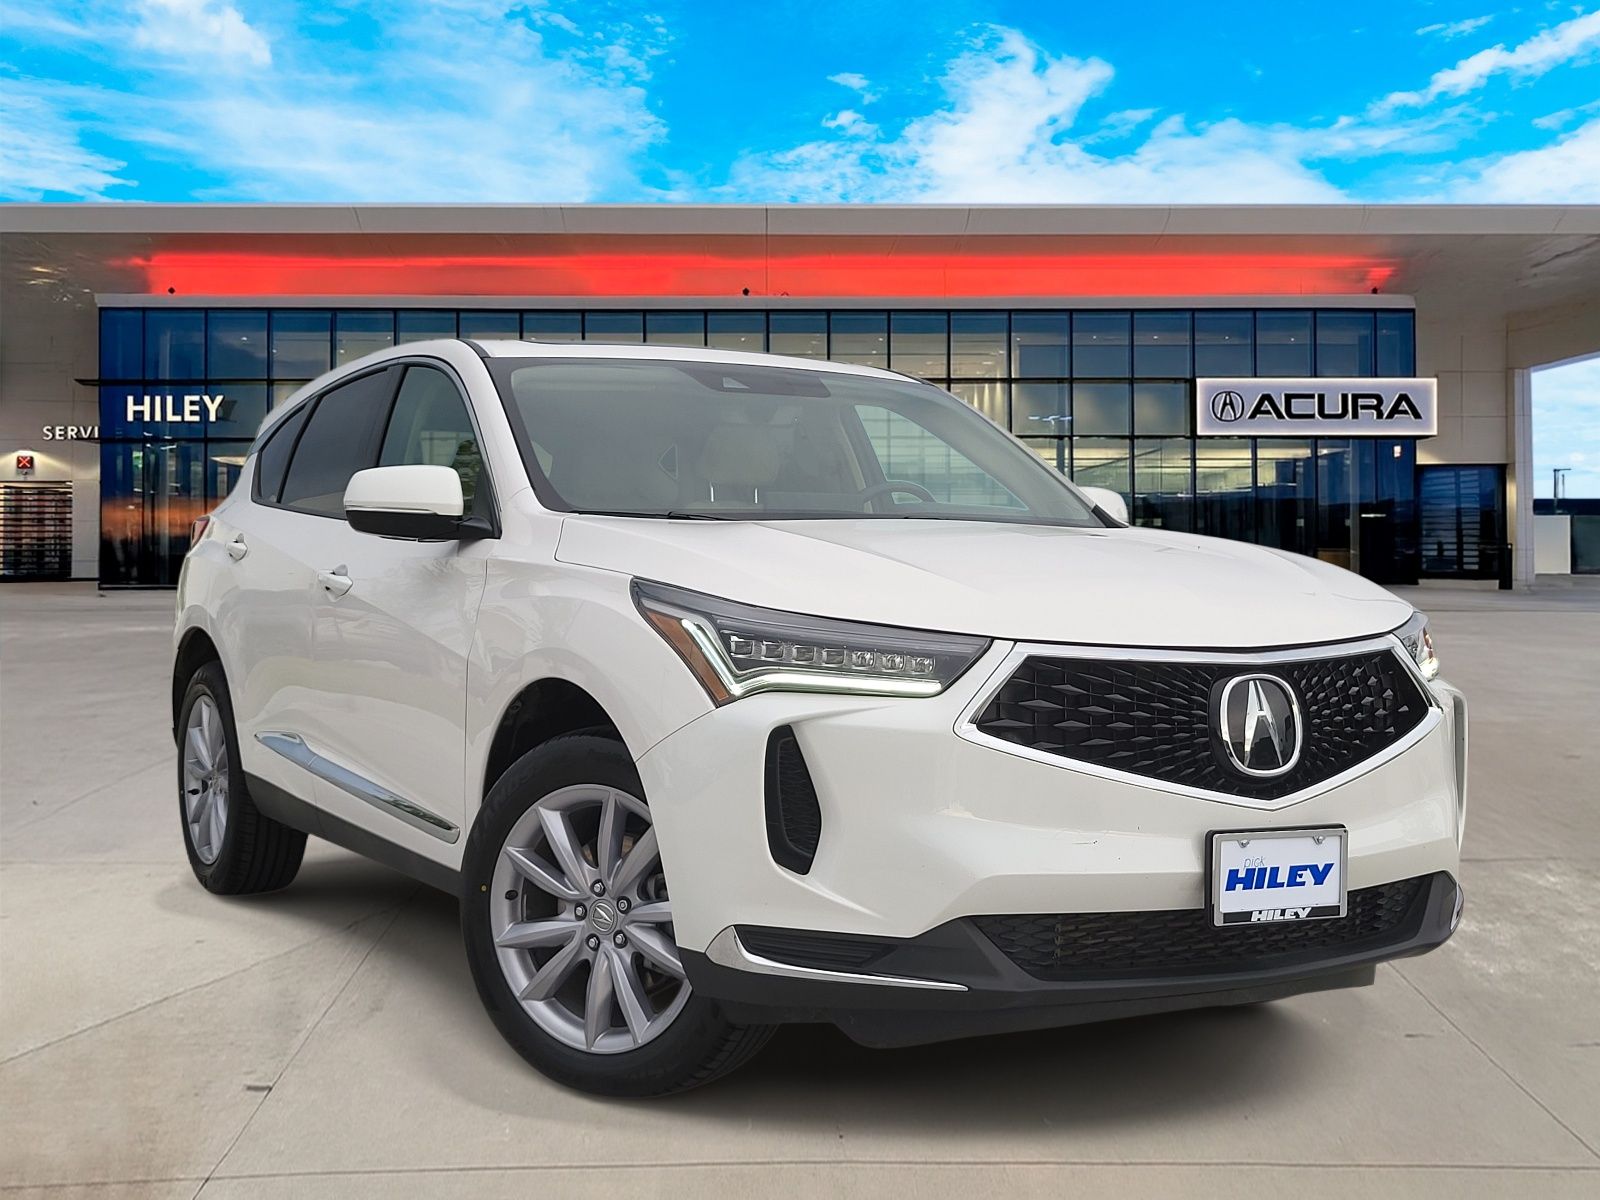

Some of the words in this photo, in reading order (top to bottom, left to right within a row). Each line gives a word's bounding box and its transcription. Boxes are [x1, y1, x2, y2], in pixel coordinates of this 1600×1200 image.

[126, 395, 224, 422] HILEY
[1248, 393, 1423, 420] ACURA
[1225, 862, 1335, 892] HILEY
[1250, 907, 1312, 922] HILEY
